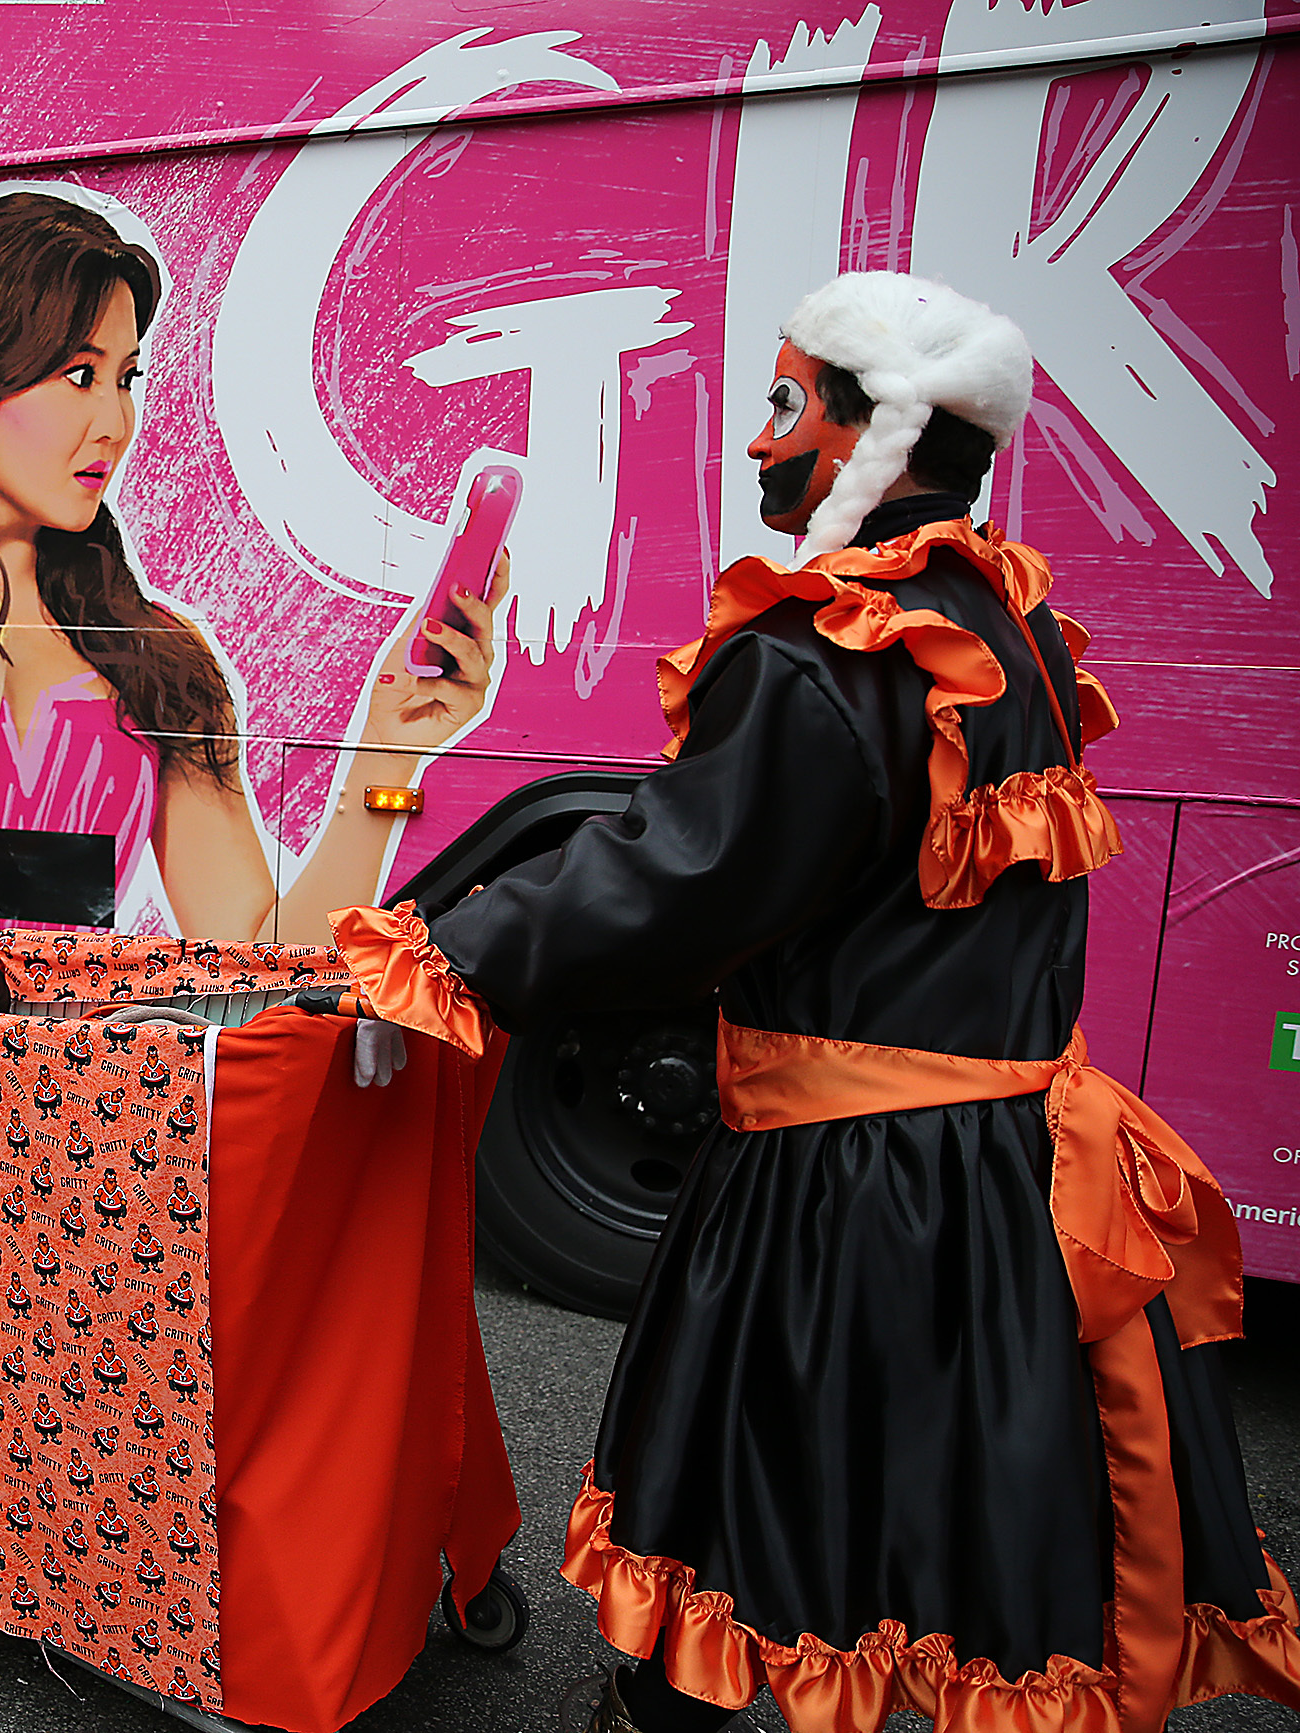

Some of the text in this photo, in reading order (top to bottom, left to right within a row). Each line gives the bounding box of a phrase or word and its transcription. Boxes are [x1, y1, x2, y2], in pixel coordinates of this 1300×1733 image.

[225, 946, 250, 968] GRITTY
[290, 947, 315, 958] GRITTY
[58, 969, 81, 979] GRITTY
[114, 963, 139, 971] GRITTY
[323, 972, 349, 980] GRITTY
[141, 986, 164, 996] GRITTY
[33, 1042, 59, 1059] GRITTY
[101, 1060, 130, 1080] GRITTY
[5, 1070, 27, 1102] GRITTY
[67, 1091, 90, 1108] GRITTY
[130, 1103, 161, 1122] GRITTY
[35, 1130, 61, 1149] GRITTY
[100, 1139, 127, 1153] GRITTY
[0, 1161, 25, 1179] GRITTY
[166, 1155, 196, 1171] GRITTY
[61, 1177, 88, 1190] GRITTY
[133, 1184, 160, 1216] GRITTY
[32, 1210, 55, 1228] GRITTY
[6, 1235, 27, 1266] GRITTY
[95, 1234, 122, 1255] GRITTY
[172, 1244, 201, 1263] GRITTY
[65, 1261, 86, 1278] GRITTY
[125, 1278, 157, 1295] GRITTY
[36, 1295, 60, 1315] GRITTY
[97, 1311, 123, 1324] GRITTY
[1, 1321, 26, 1341] GRITTY
[165, 1327, 193, 1345] GRITTY
[62, 1342, 87, 1356] GRITTY
[133, 1353, 159, 1385] GRITTY
[31, 1372, 57, 1389] GRITTY
[8, 1393, 28, 1423] GRITTY
[95, 1399, 123, 1420] GRITTY
[66, 1421, 88, 1439] GRITTY
[172, 1412, 199, 1433] GRITTY
[126, 1441, 158, 1460] GRITTY
[37, 1452, 62, 1472] GRITTY
[5, 1474, 30, 1492] GRITTY
[99, 1473, 124, 1483] GRITTY
[63, 1499, 89, 1513] GRITTY
[166, 1490, 194, 1509] GRITTY
[38, 1522, 59, 1542] GRITTY
[134, 1514, 161, 1543] GRITTY
[10, 1542, 35, 1570] GRITTY
[97, 1554, 125, 1575] GRITTY
[69, 1573, 90, 1592] GRITTY
[172, 1571, 201, 1592] GRITTY
[46, 1597, 69, 1618] GRITTY
[129, 1596, 160, 1615] GRITTY
[3, 1621, 34, 1638] GRITTY
[102, 1625, 128, 1634] GRITTY
[167, 1645, 195, 1664] GRITTY
